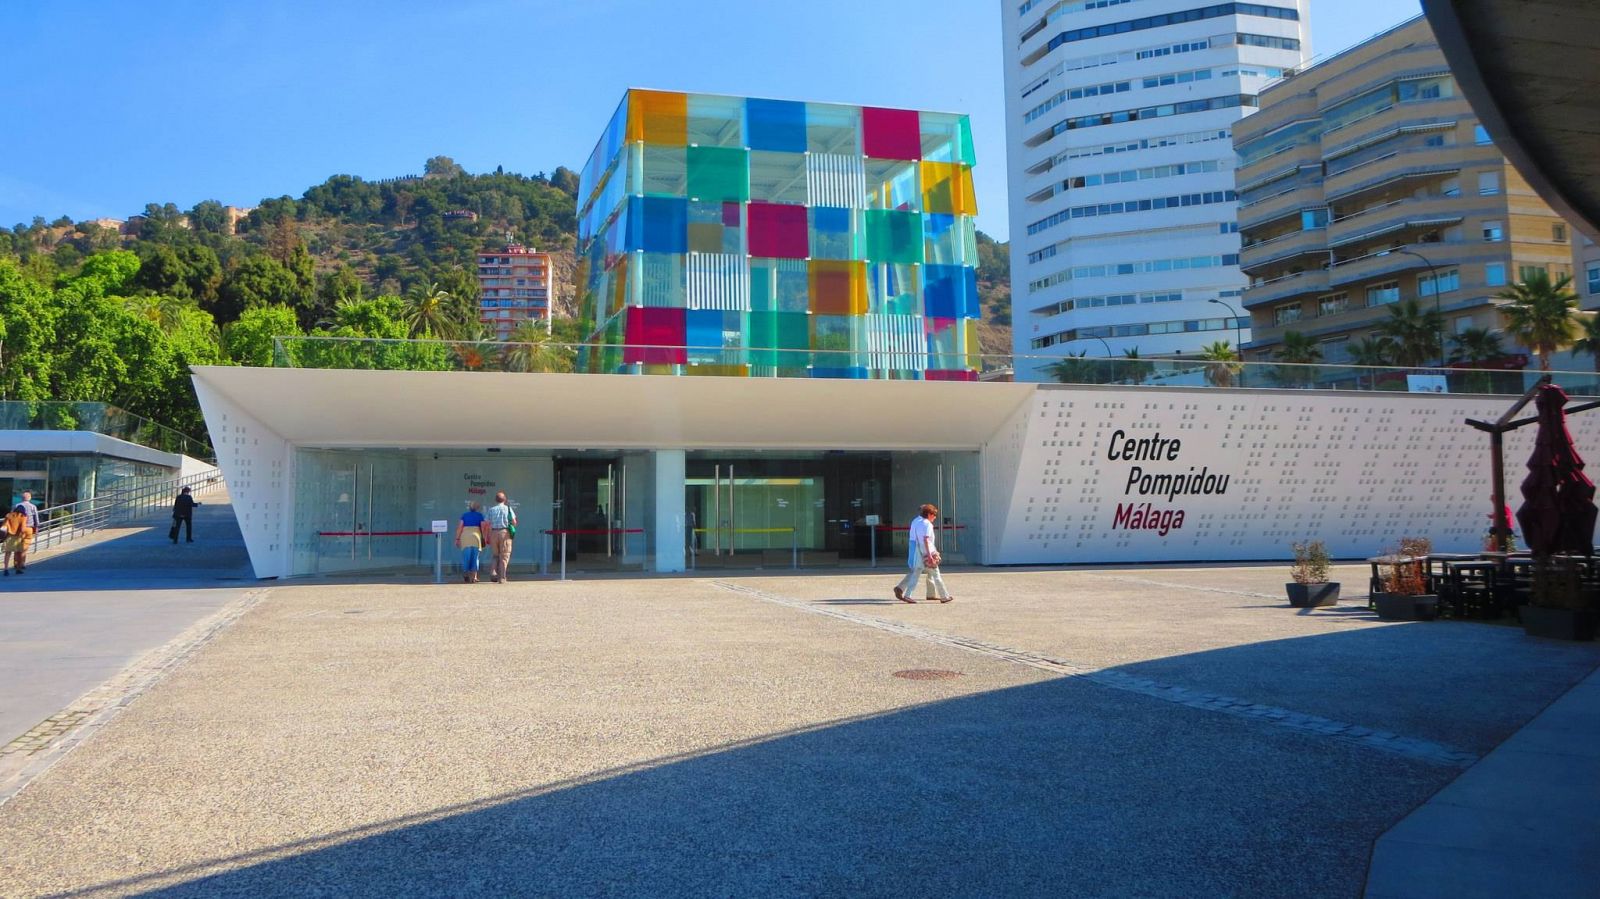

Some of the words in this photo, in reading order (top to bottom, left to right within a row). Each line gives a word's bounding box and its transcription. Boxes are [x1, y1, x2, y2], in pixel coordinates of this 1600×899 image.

[1108, 430, 1181, 461] Centre
[1125, 466, 1230, 502] Pompidou
[1112, 503, 1185, 536] Málaga
